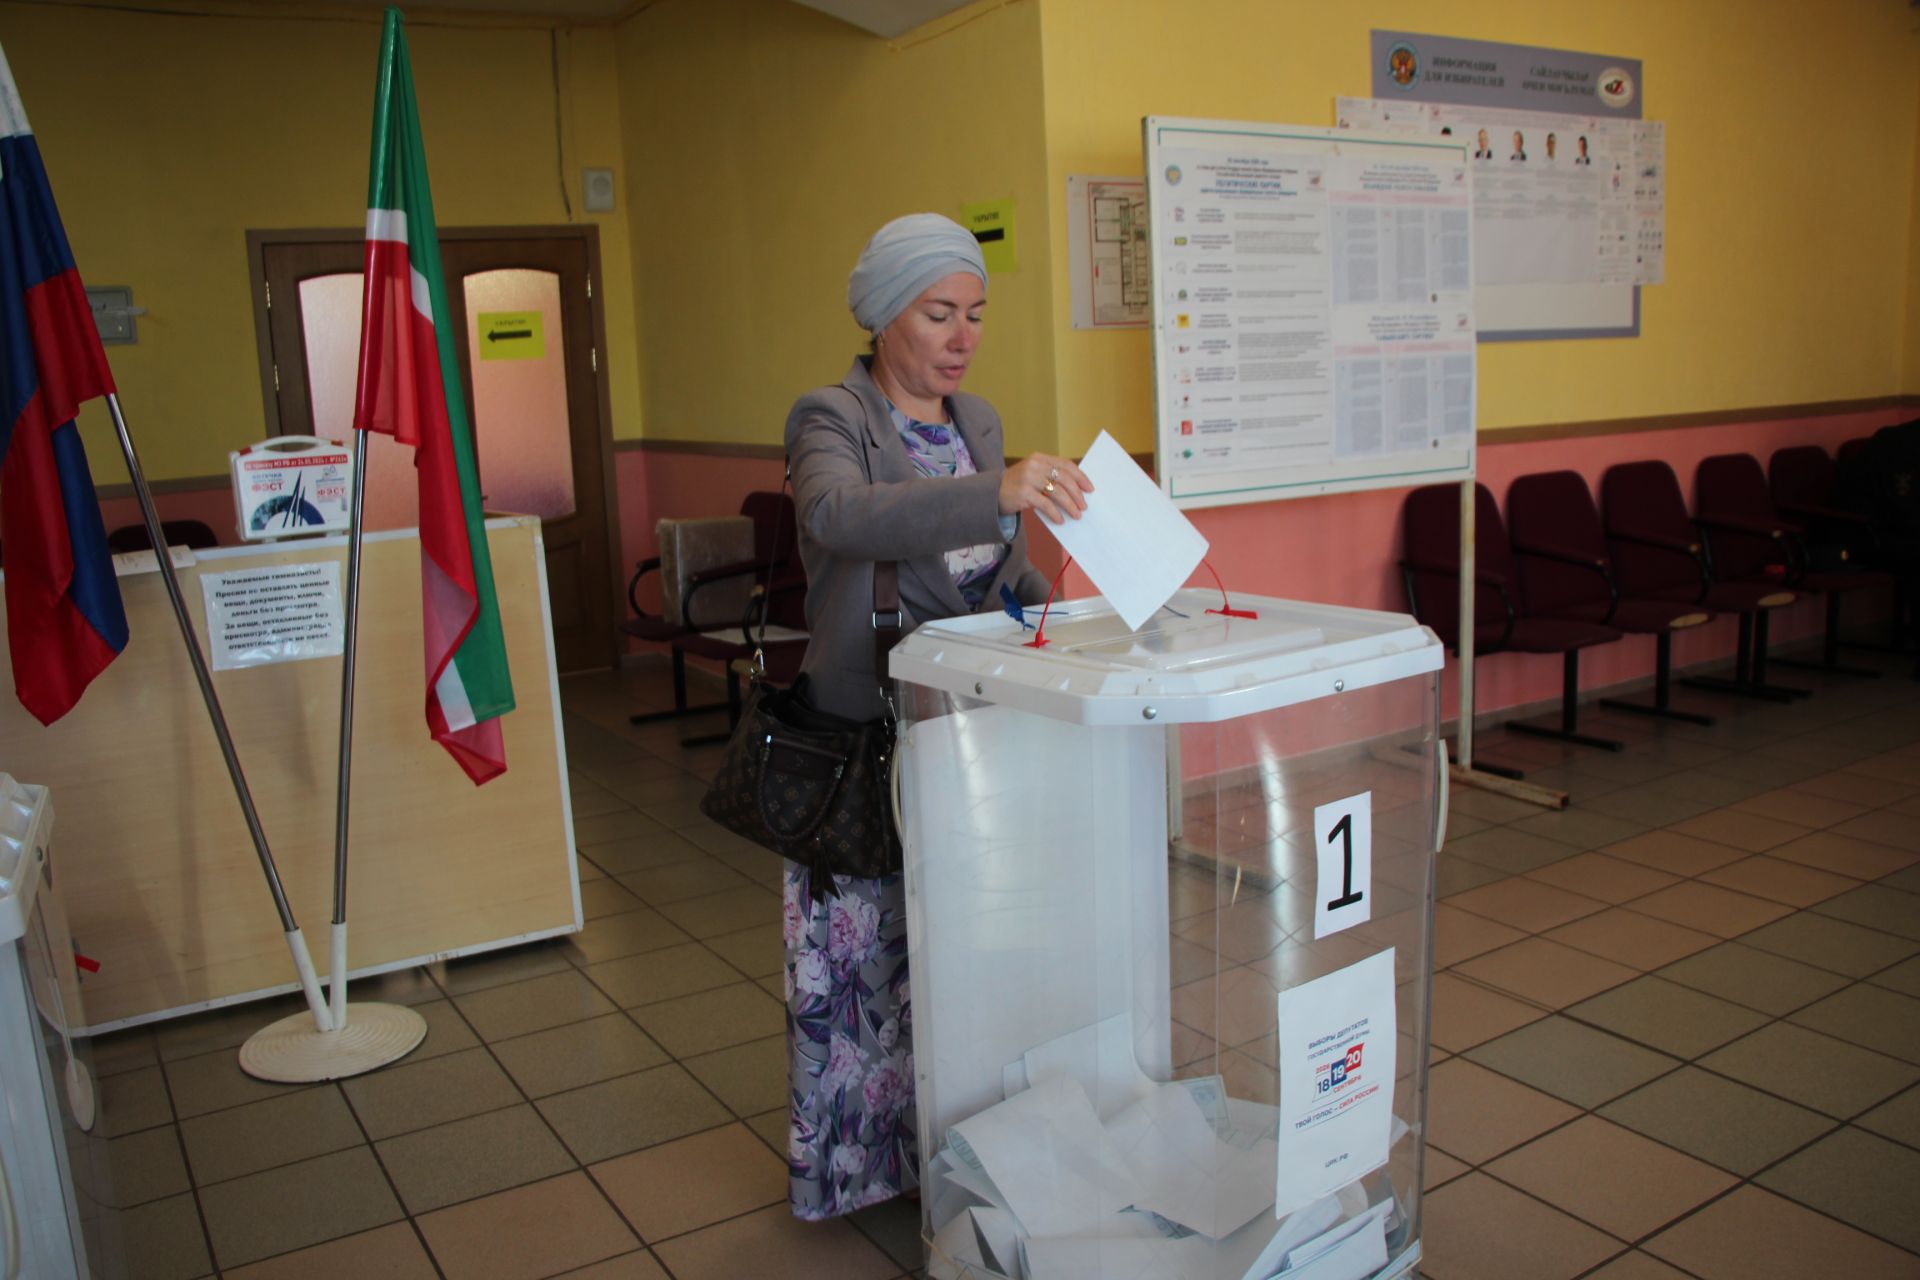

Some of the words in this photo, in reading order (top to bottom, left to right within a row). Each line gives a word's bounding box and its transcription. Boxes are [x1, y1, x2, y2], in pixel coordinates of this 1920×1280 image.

[1432, 56, 1496, 72] ИНФОРМАЦИЯ
[1424, 71, 1443, 82] ДЛЯ
[1445, 73, 1504, 87] ИЗБИРАТЕЛЕЙ
[251, 481, 284, 492] ФЭСТ
[215, 590, 247, 599] Просим
[260, 584, 298, 593] оставлять
[250, 595, 296, 606] документы,
[232, 608, 258, 618] деньги
[225, 622, 235, 630] За
[1326, 812, 1363, 912] 1
[1308, 1033, 1336, 1050] ВЫБОРЫ
[1337, 1018, 1369, 1039] ДЕПУТАТОВ
[1307, 1034, 1355, 1060] ГОСУДАРСТВЕННОЙ
[1346, 1049, 1362, 1068] 20
[1333, 1064, 1345, 1082] 19
[1317, 1078, 1330, 1094] 18
[1333, 1074, 1362, 1093] СЕНТЯБРЯ
[1295, 1115, 1312, 1129] ТВОЙ
[1313, 1107, 1333, 1121] ГОЛОС
[1339, 1097, 1354, 1110] СИЛА
